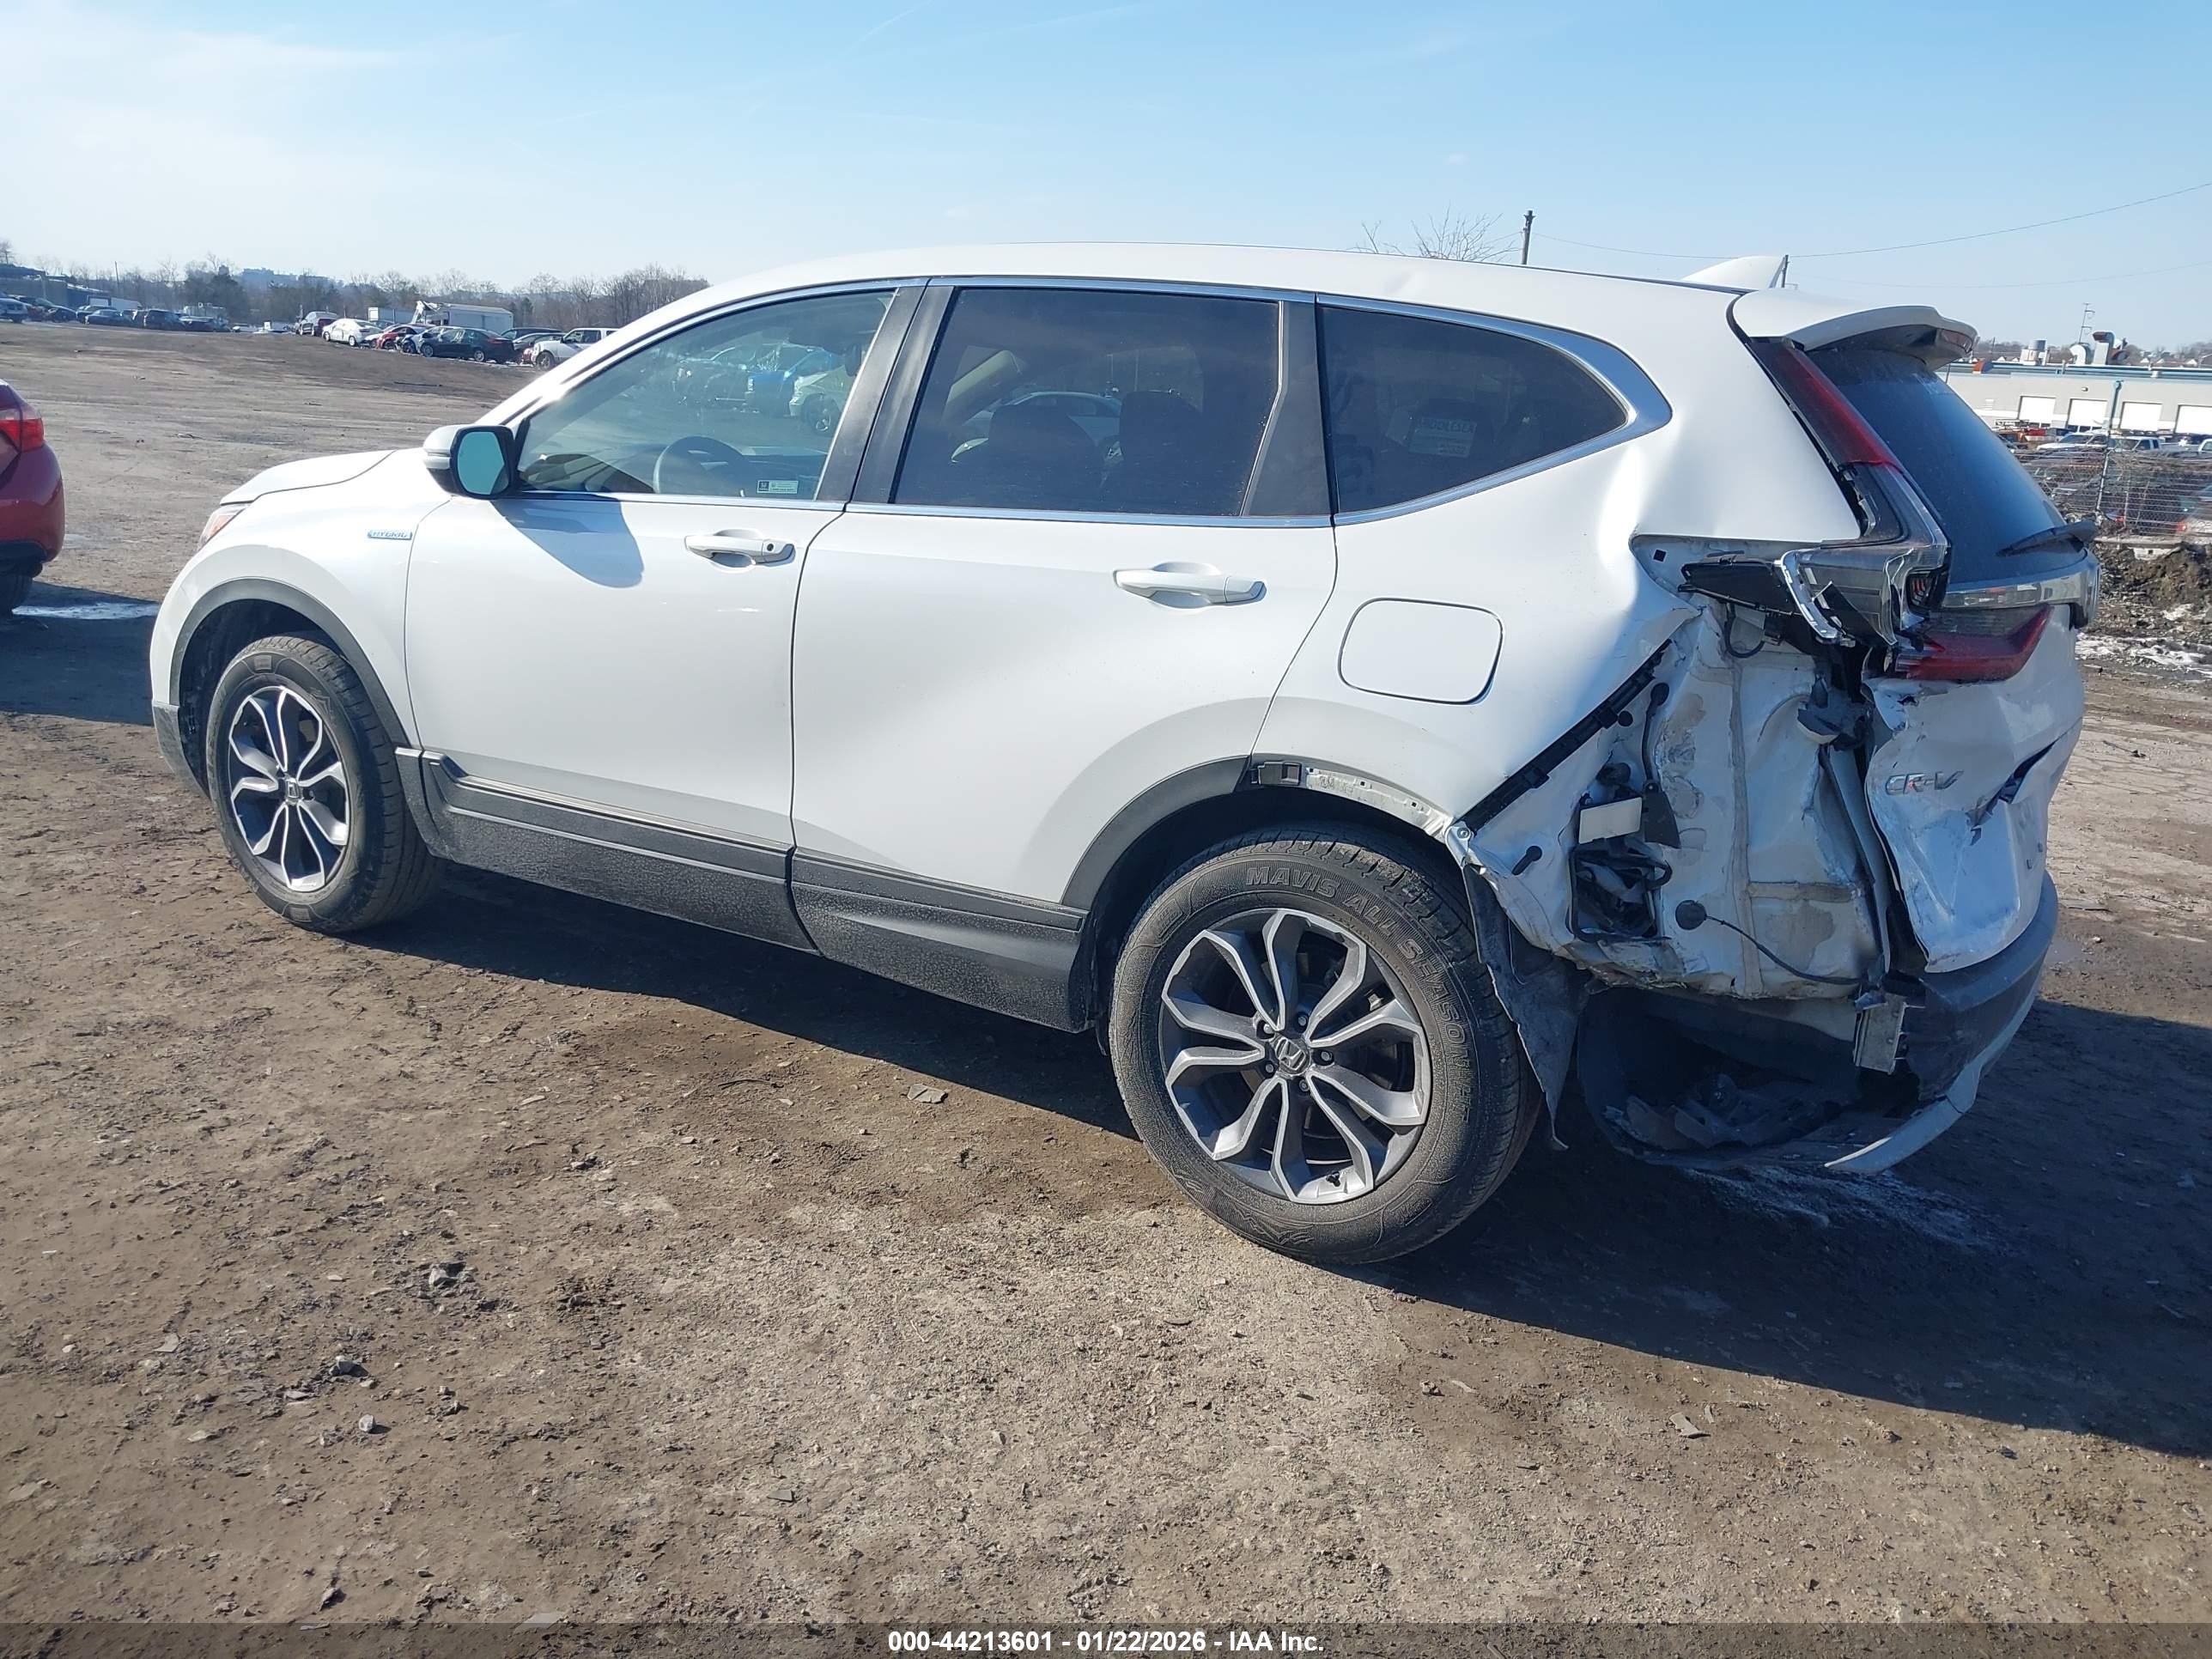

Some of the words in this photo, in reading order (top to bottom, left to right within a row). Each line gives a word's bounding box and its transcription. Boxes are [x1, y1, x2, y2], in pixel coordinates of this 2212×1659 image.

[1885, 769, 1965, 796] CR-V
[1245, 866, 1340, 898] MAVIS
[1343, 894, 1398, 937] ALL
[1396, 938, 1470, 1068] SEASON
